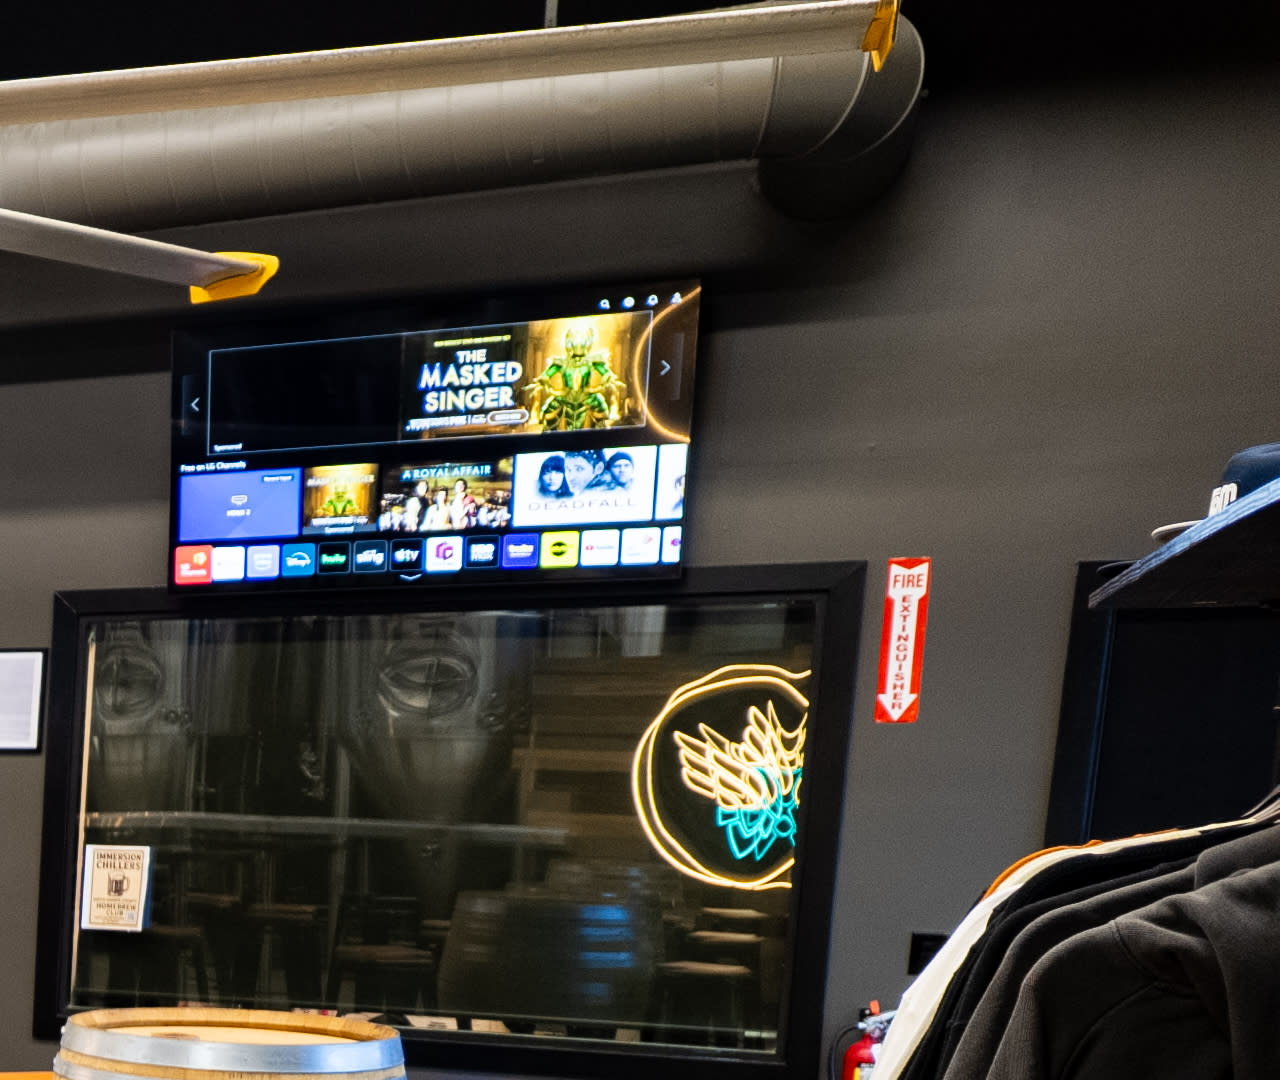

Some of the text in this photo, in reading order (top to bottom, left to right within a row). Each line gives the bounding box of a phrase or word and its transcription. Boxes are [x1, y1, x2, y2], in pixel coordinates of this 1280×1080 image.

[455, 348, 488, 363] THE
[418, 361, 524, 390] MASKED
[424, 385, 515, 413] SINGER
[180, 464, 193, 472] Free
[205, 463, 215, 471] LG
[215, 461, 247, 471] Channels
[401, 464, 492, 480] A ROYAL AFFAIR
[528, 498, 638, 511] DEADFALL
[320, 553, 347, 565] hulu
[892, 573, 925, 589] FIRE
[890, 594, 913, 711] EXTINGUISHER
[95, 852, 142, 861] IMMERSION
[95, 861, 142, 871] CHILLERS
